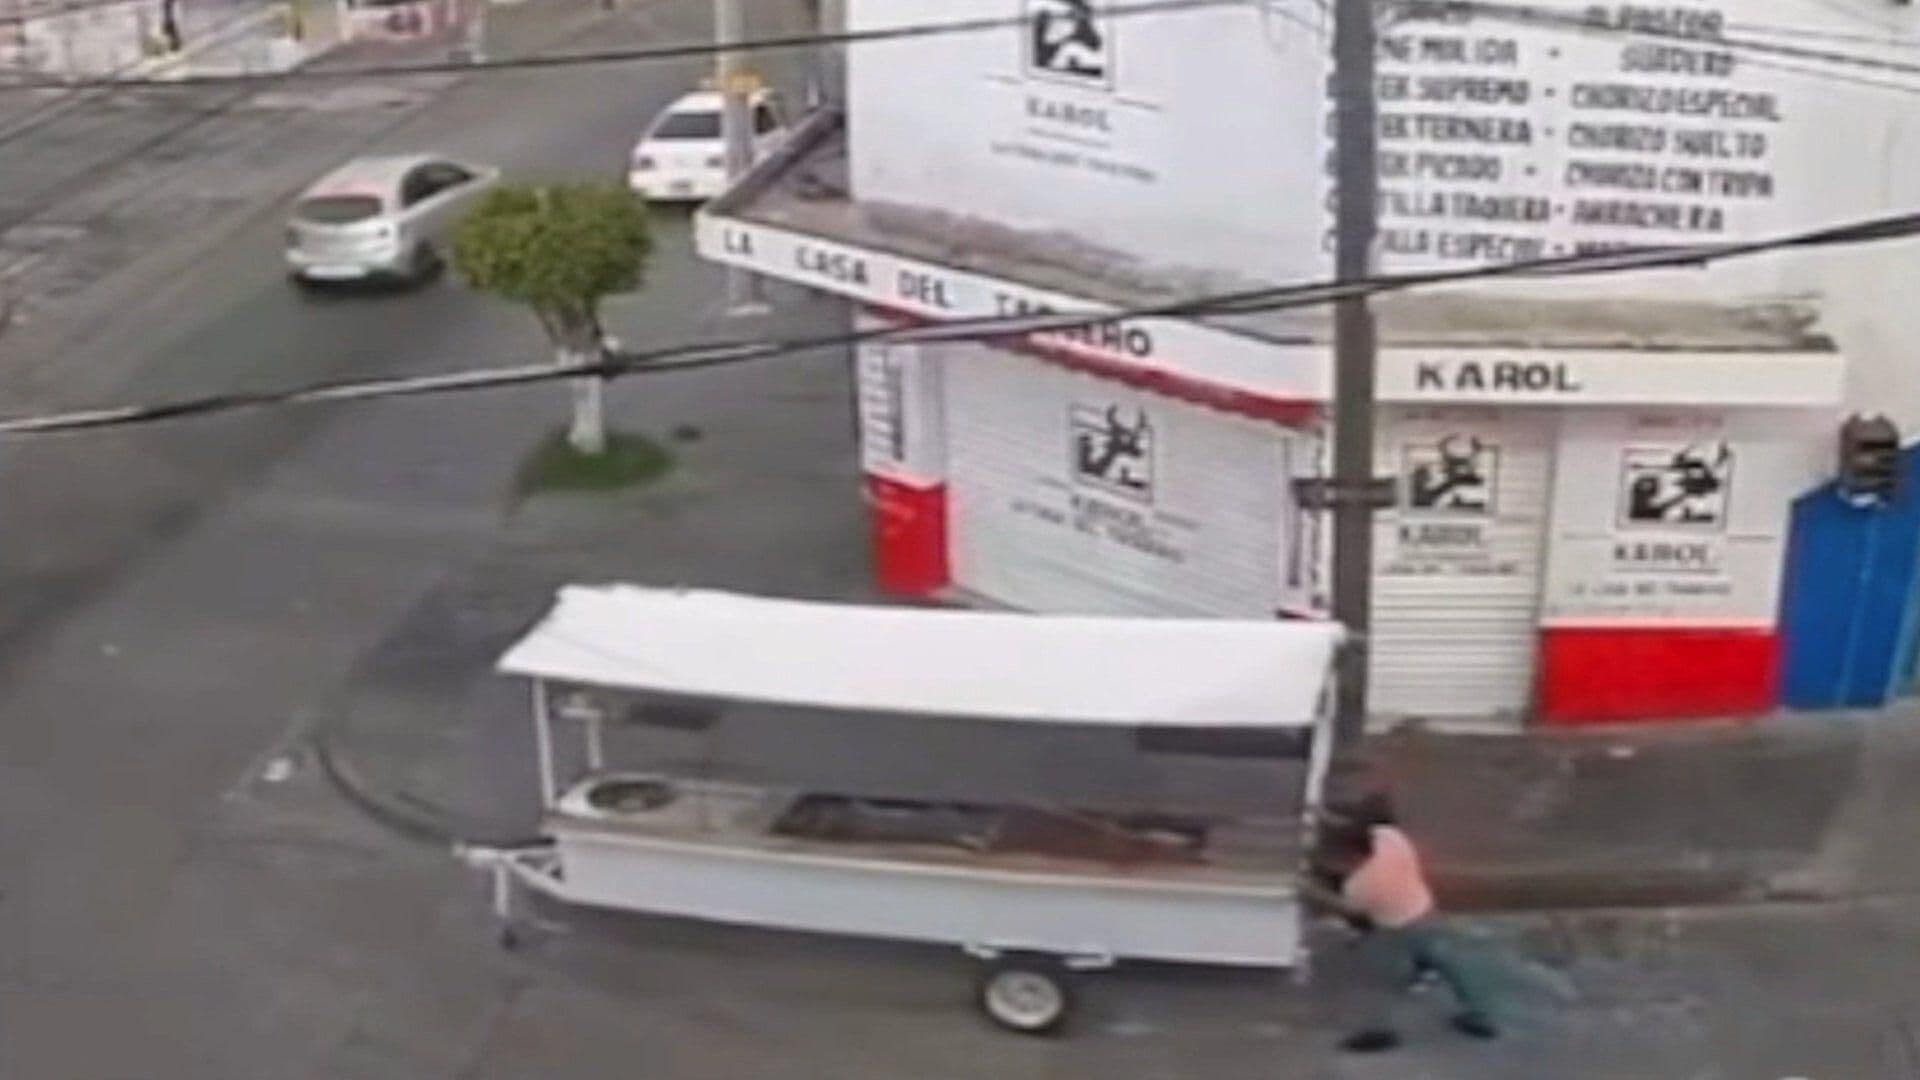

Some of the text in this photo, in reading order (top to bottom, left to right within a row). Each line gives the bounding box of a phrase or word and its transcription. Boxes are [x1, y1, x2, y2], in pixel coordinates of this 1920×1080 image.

[725, 229, 753, 256] LA
[795, 245, 869, 285] CASA
[899, 269, 950, 309] DEL
[1416, 360, 1583, 392] KAROL
